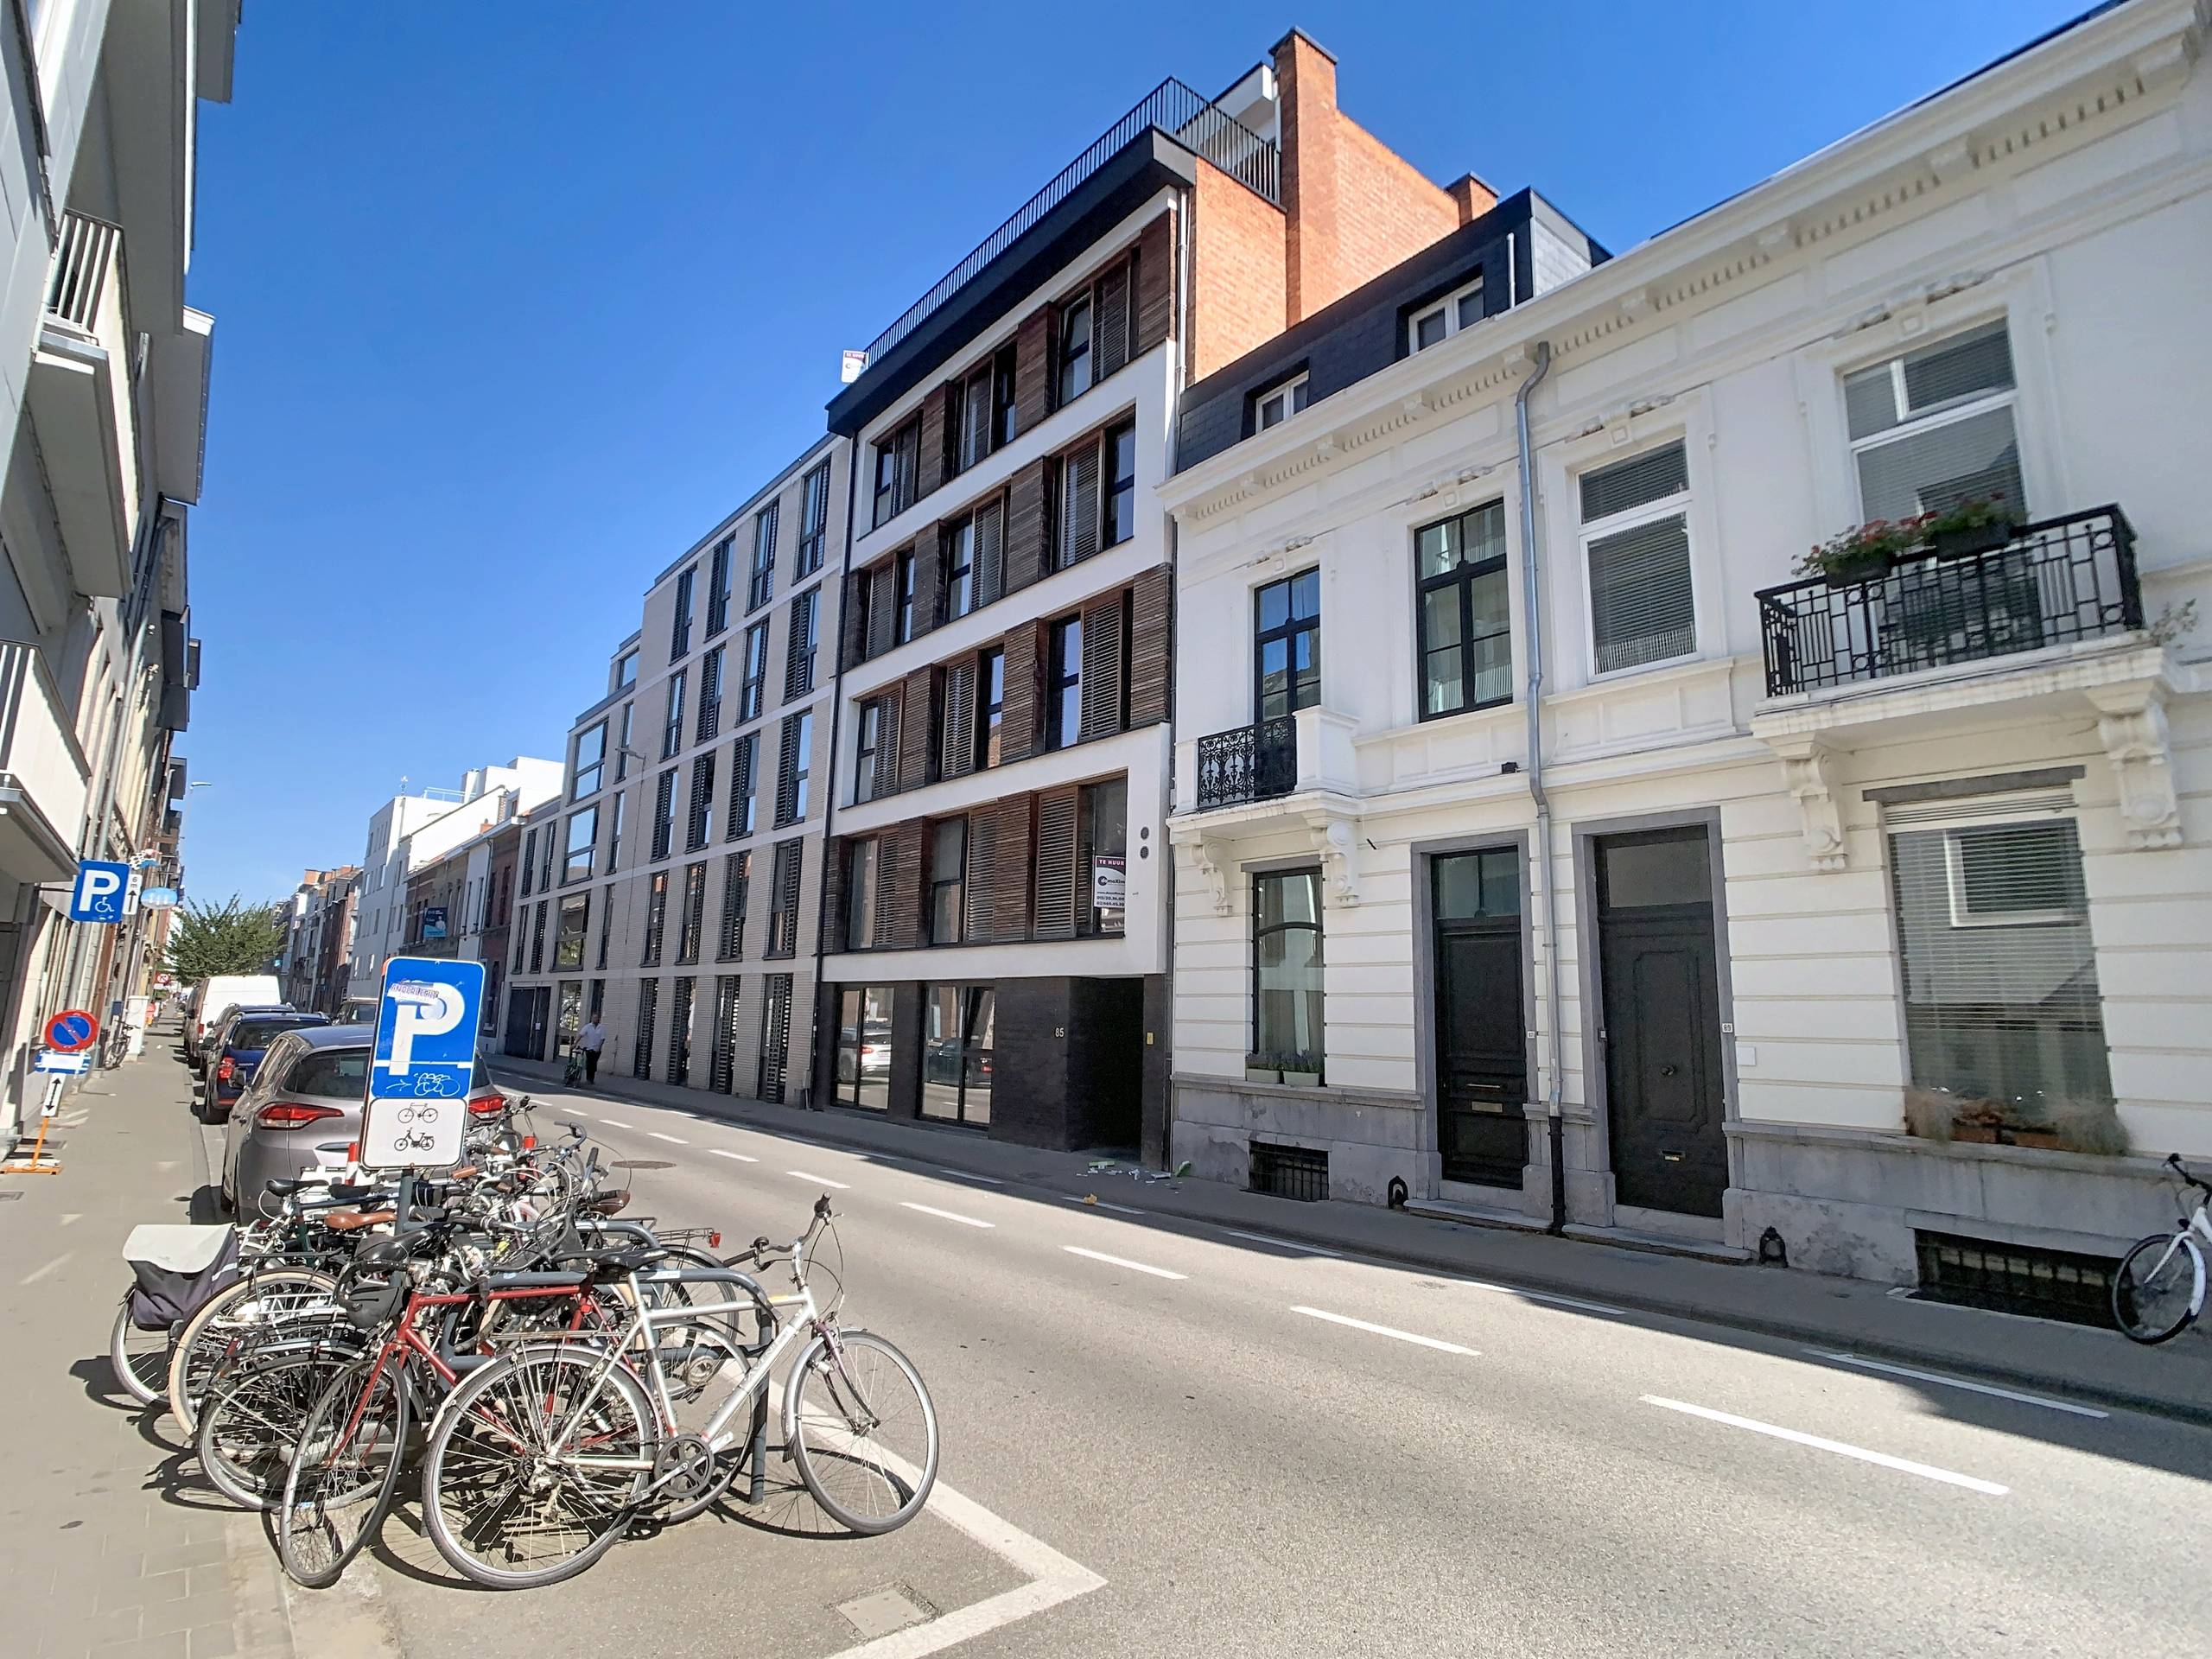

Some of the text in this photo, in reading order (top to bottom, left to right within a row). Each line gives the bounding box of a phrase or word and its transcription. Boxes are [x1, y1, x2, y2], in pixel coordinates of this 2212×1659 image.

[79, 869, 120, 912] P
[389, 982, 465, 1075] P
[1055, 1027, 1065, 1037] 85
